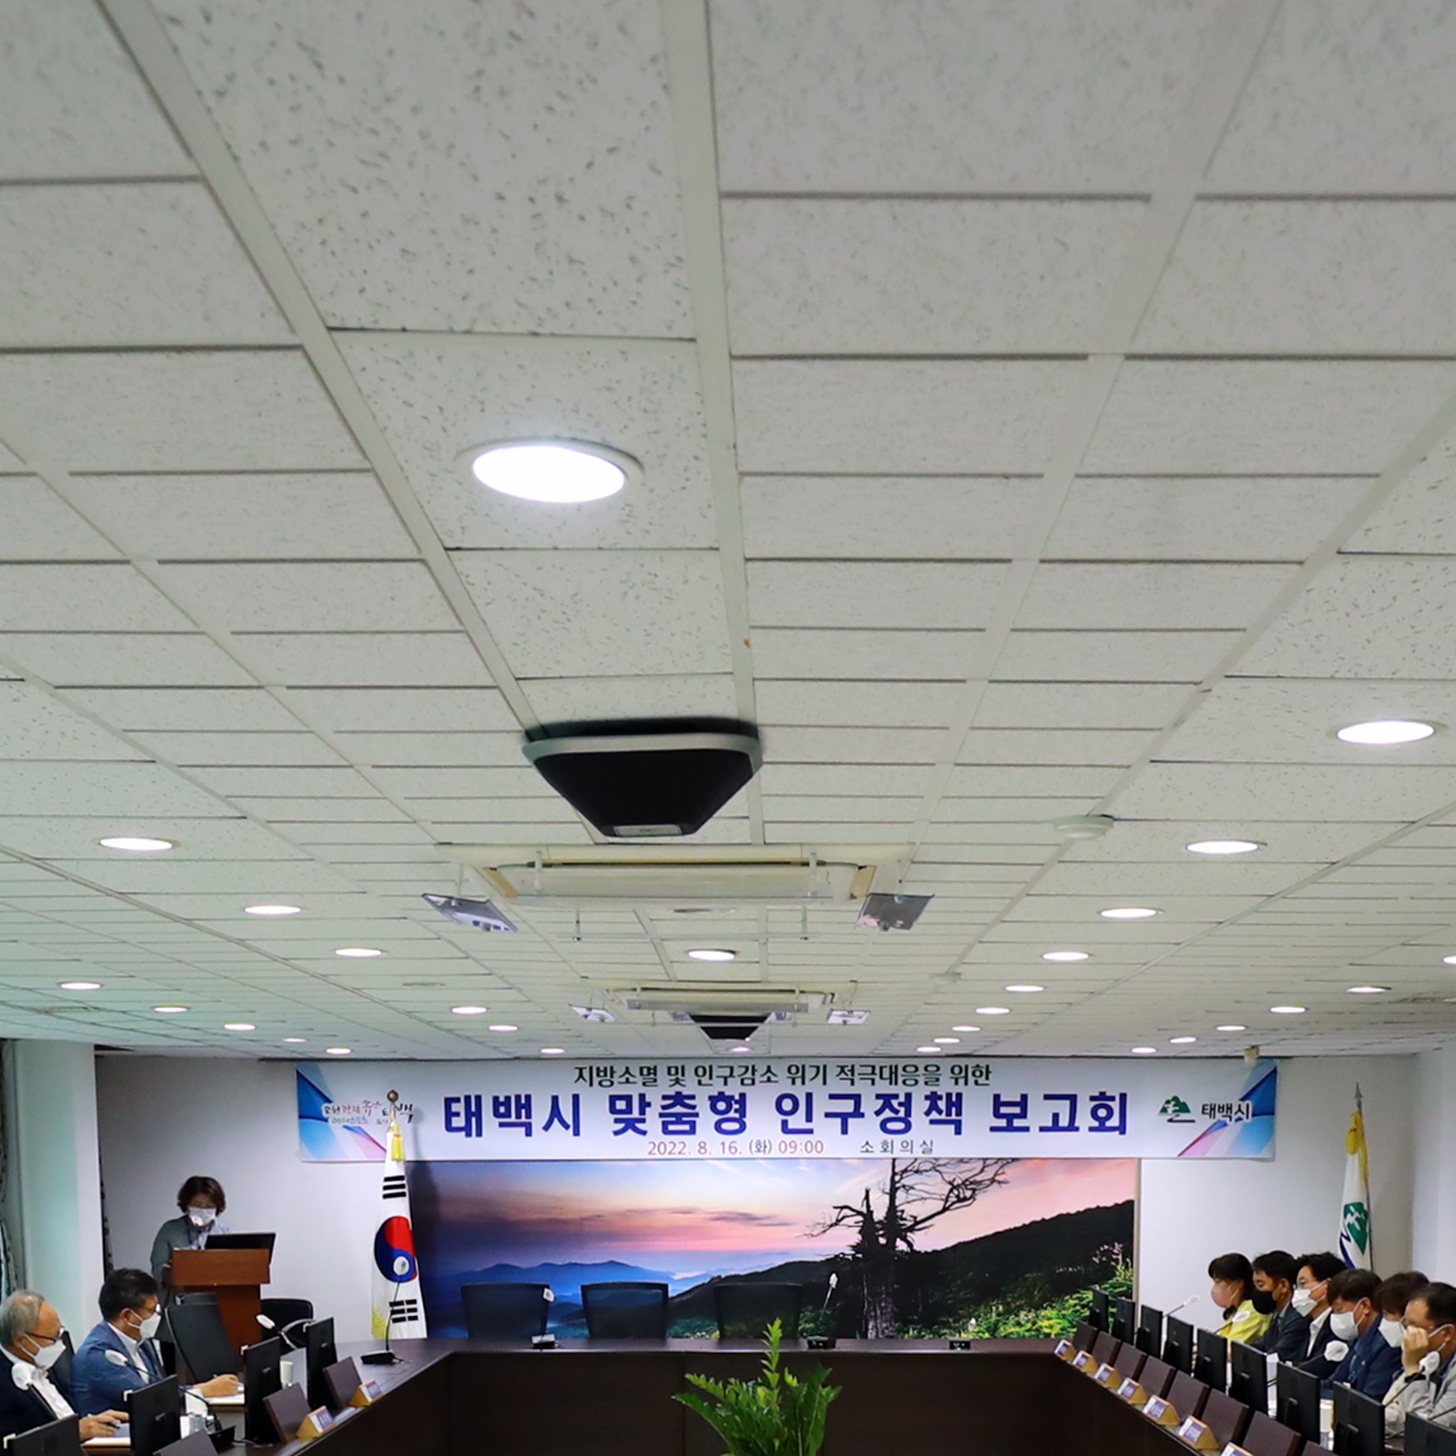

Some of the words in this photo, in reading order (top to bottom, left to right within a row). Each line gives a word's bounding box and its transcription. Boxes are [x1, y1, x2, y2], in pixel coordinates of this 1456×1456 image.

[574, 1064, 658, 1088] 지방소멸
[667, 1065, 687, 1087] 및
[694, 1064, 779, 1087] 인구감소
[786, 1064, 828, 1086] 위기
[835, 1064, 942, 1087] 적극대응을
[950, 1064, 992, 1087] 위한
[443, 1093, 581, 1138] 태백시
[608, 1091, 748, 1136] 맞춤형
[774, 1091, 963, 1136] 인구정책
[989, 1091, 1127, 1136] 보고회
[1201, 1102, 1253, 1122] 태백시
[647, 1141, 691, 1155] 2022.
[697, 1141, 712, 1155] 8.
[720, 1141, 742, 1155] 16.
[748, 1139, 772, 1155] (화)
[778, 1140, 824, 1154] 09:00
[859, 1139, 935, 1155] 소회의실
